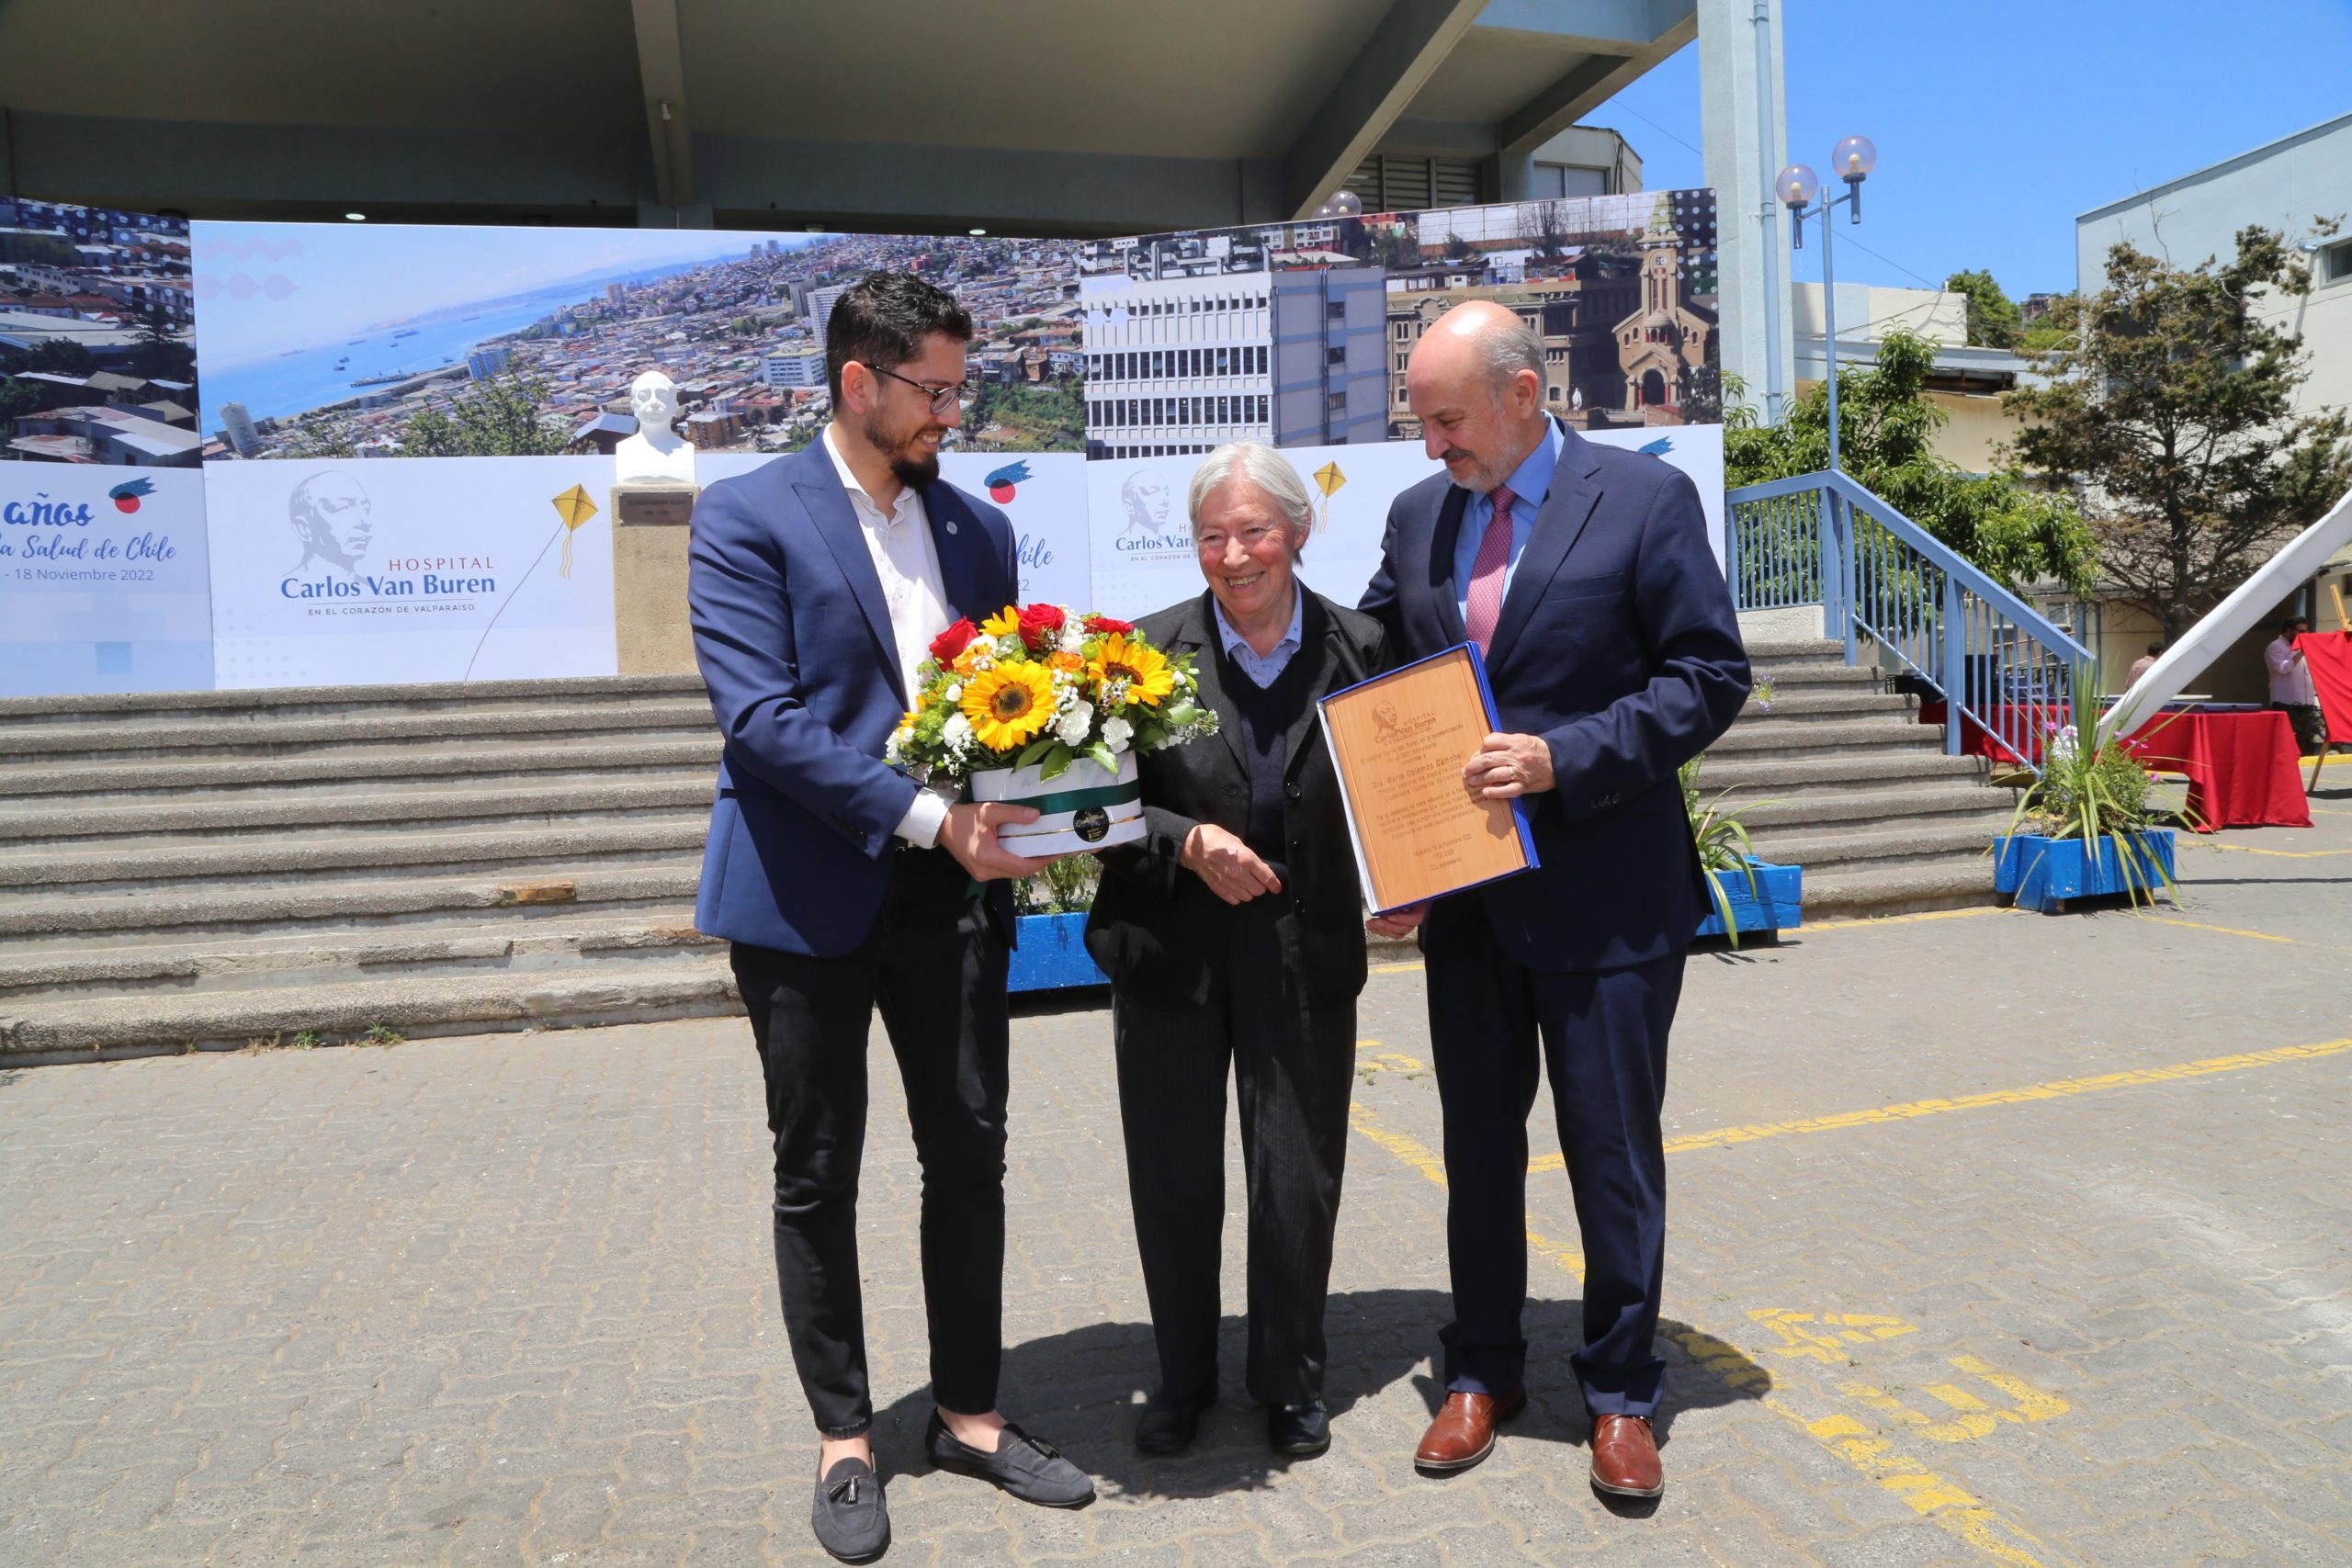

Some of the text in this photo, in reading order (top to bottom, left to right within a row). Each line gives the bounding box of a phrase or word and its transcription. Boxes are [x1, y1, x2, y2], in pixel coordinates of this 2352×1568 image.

[4, 492, 95, 526] años
[23, 534, 89, 559] Salud
[95, 538, 119, 559] de
[127, 532, 176, 561] Chile
[1016, 534, 1054, 569] hile
[1115, 536, 1162, 551] Carlos
[390, 557, 494, 571] HOSPITAL
[15, 569, 32, 580] 18
[37, 569, 116, 581] Noviembre
[121, 570, 153, 581] 2022
[280, 574, 495, 599] Carlos Van Buren
[343, 604, 390, 615] CORAZÓN
[414, 604, 475, 612] VALPARAÍSO
